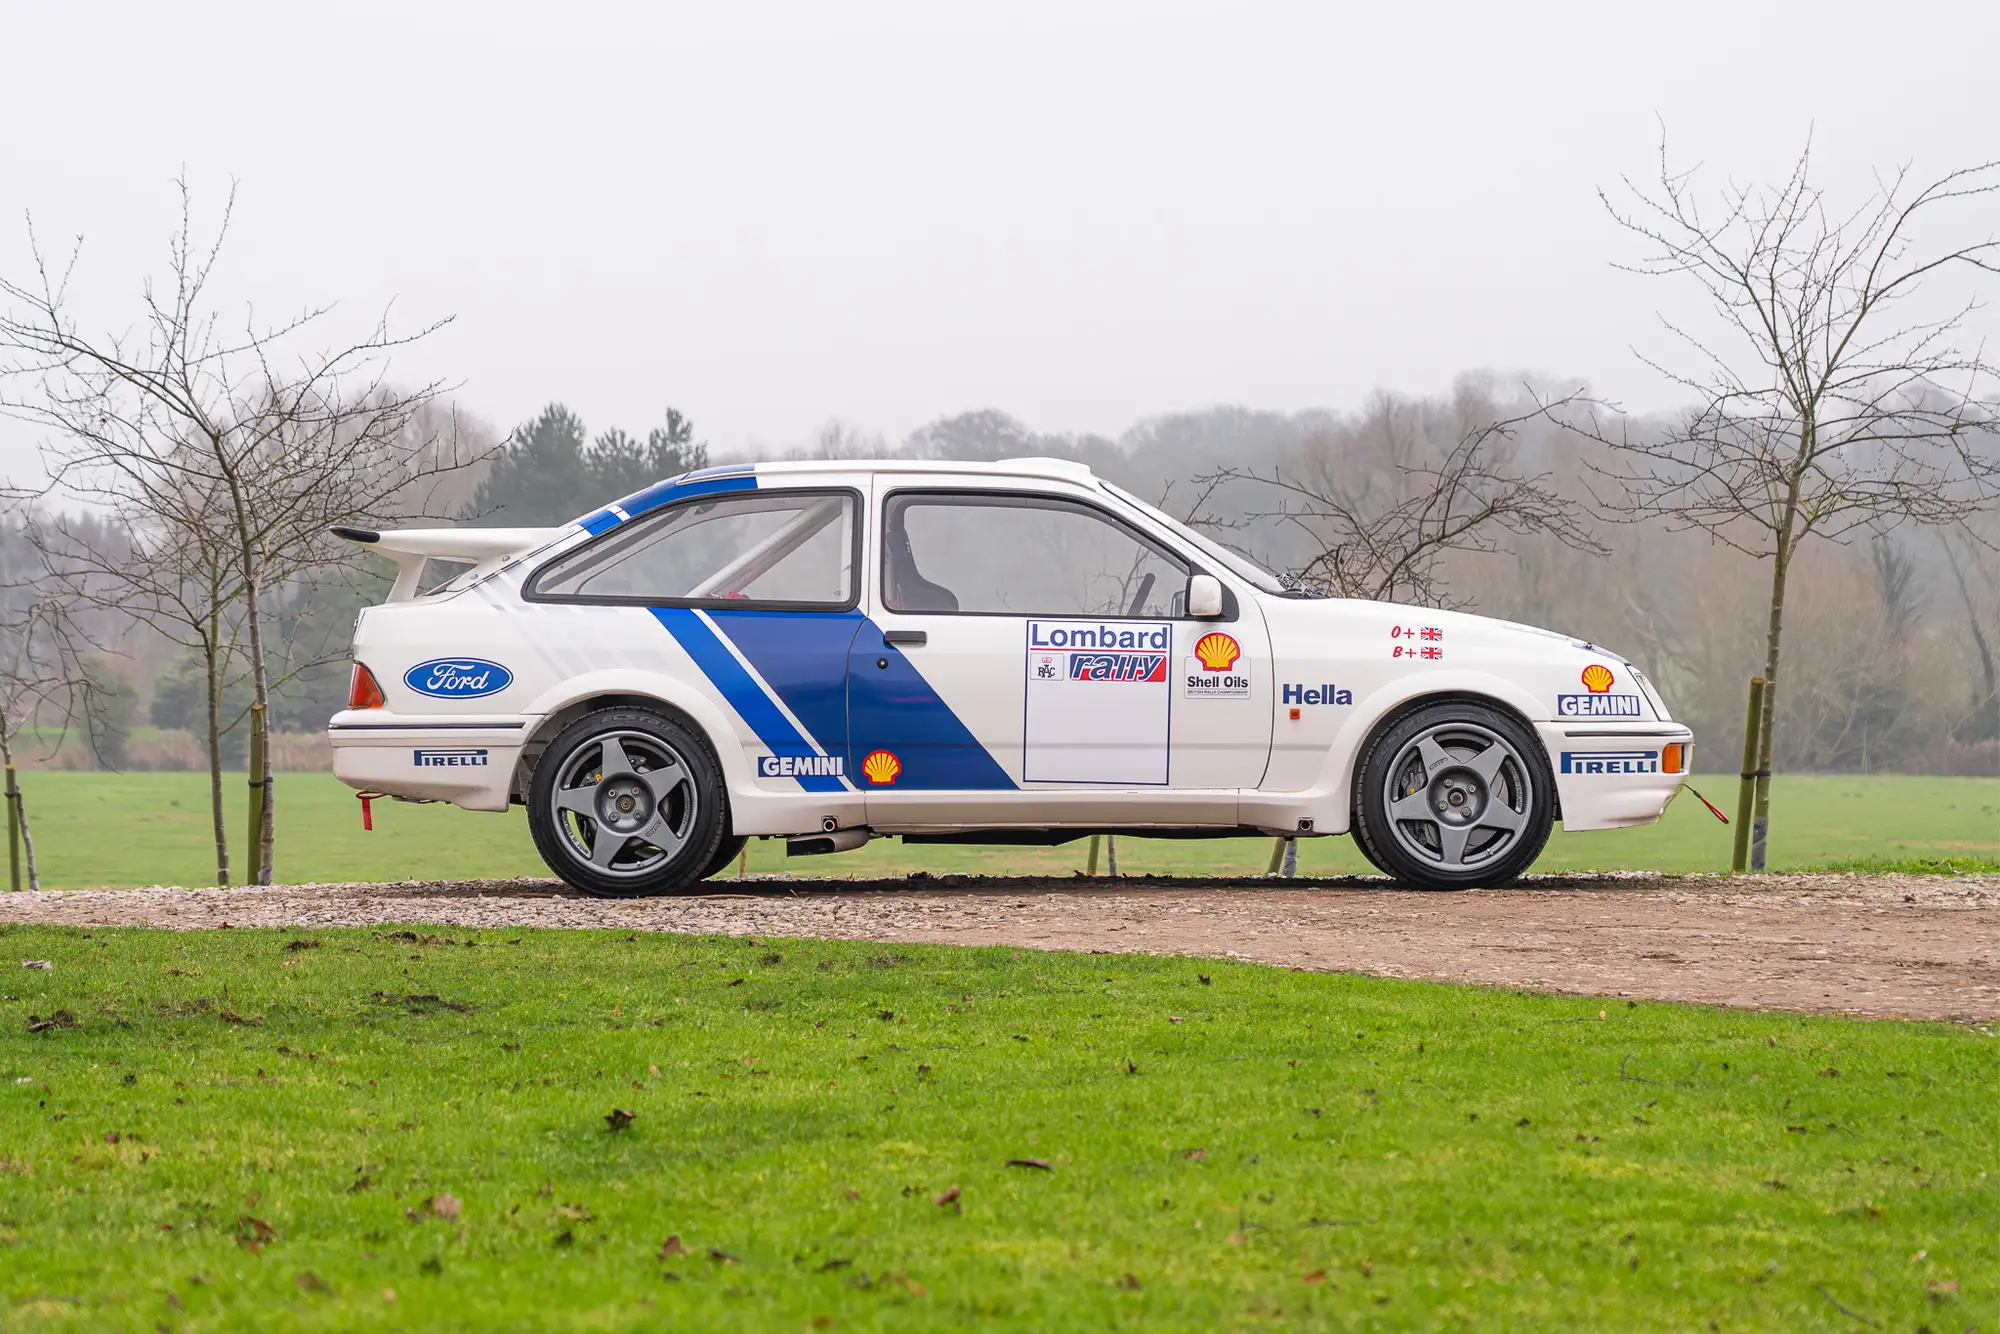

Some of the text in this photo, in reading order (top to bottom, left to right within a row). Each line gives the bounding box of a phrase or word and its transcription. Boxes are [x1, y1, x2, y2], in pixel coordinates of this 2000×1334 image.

[1031, 623, 1168, 649] Lombard
[426, 663, 490, 690] Ford
[1037, 664, 1056, 678] RAC
[1071, 655, 1163, 681] rally
[1187, 676, 1249, 688] Shell Oils
[1282, 684, 1353, 706] Hella
[1560, 696, 1640, 716] GEMINI
[413, 749, 489, 767] PIRELLI
[762, 757, 844, 776] GEMINI
[1560, 751, 1659, 774] PIRELLI
